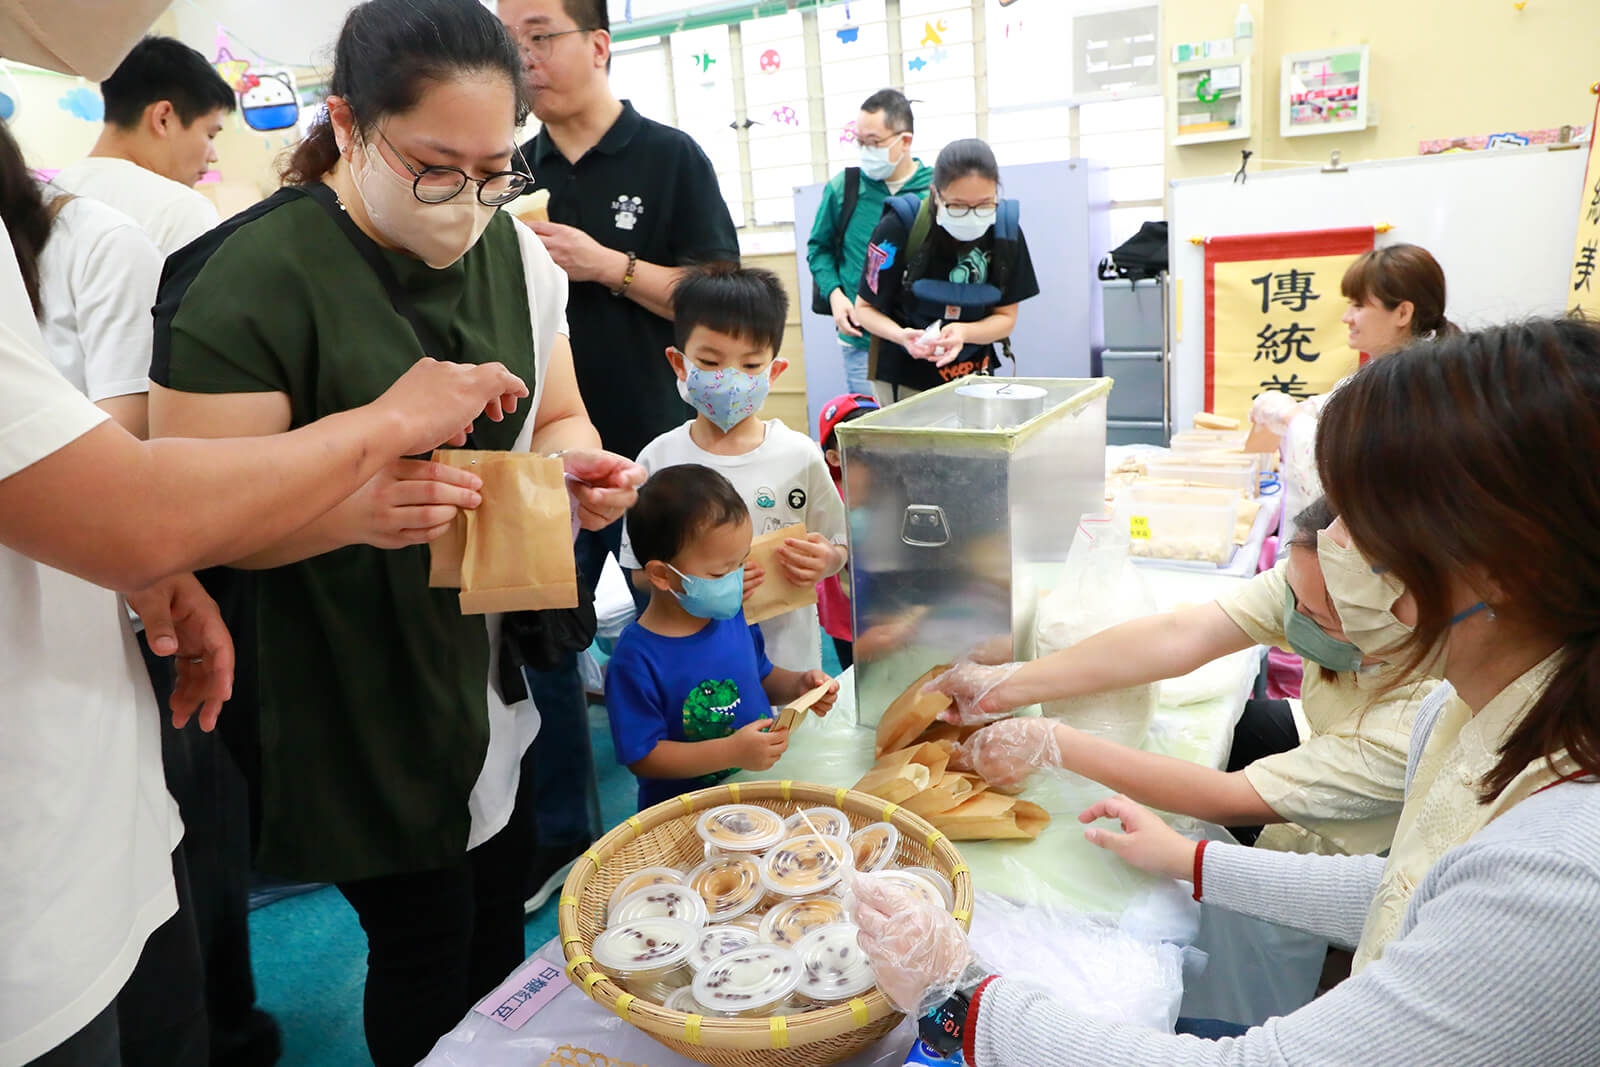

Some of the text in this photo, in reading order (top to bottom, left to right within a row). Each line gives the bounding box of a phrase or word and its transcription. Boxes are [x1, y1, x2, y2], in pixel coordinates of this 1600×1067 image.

[491, 967, 560, 1022] 白糖紅豆
[927, 1006, 961, 1038] 10:16
